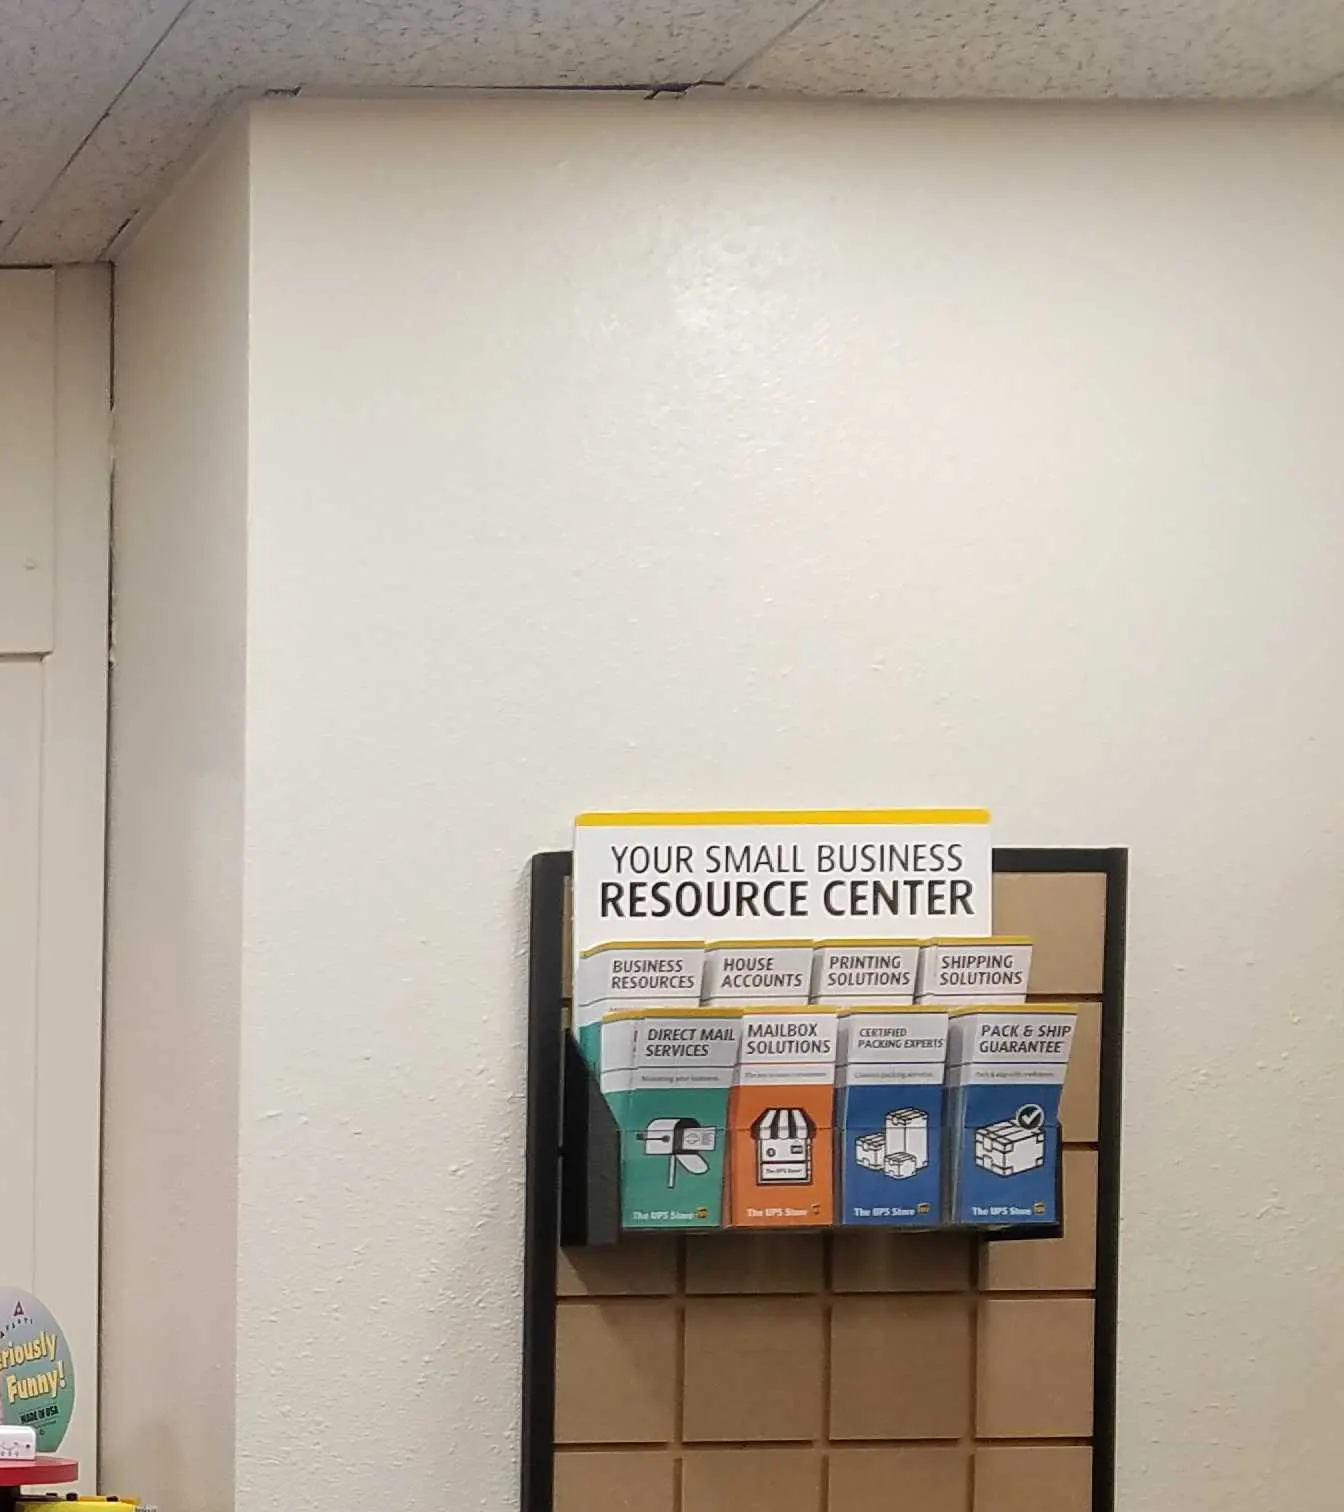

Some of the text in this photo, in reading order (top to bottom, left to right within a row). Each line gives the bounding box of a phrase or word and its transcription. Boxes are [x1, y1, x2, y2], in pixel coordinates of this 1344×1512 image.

[611, 843, 964, 874] YOUR SMALL BUSINESS
[599, 880, 976, 918] RESOURCE CENTER
[612, 959, 684, 973] BUSINESS
[723, 957, 775, 971] HOUSE
[828, 956, 902, 970] PRINTING
[941, 955, 1014, 970] SHIPPING
[611, 975, 695, 989] RESOURCES
[721, 973, 803, 988] ACCOUNTS
[827, 971, 912, 986] SOLUTIONS
[939, 971, 1023, 986] SOLUTIONS
[647, 1028, 736, 1042] DIRECT MAIL
[747, 1023, 819, 1038] MAILBOX
[859, 1027, 908, 1038] CERTIFIED
[980, 1024, 1072, 1038] PACK & SHIP
[645, 1043, 709, 1057] SERVICES
[746, 1039, 832, 1055] SOLUTIONS
[858, 1037, 945, 1049] PACKING EXPERTS
[979, 1040, 1064, 1055] GUARANTEE
[6, 1360, 66, 1404] Funny!
